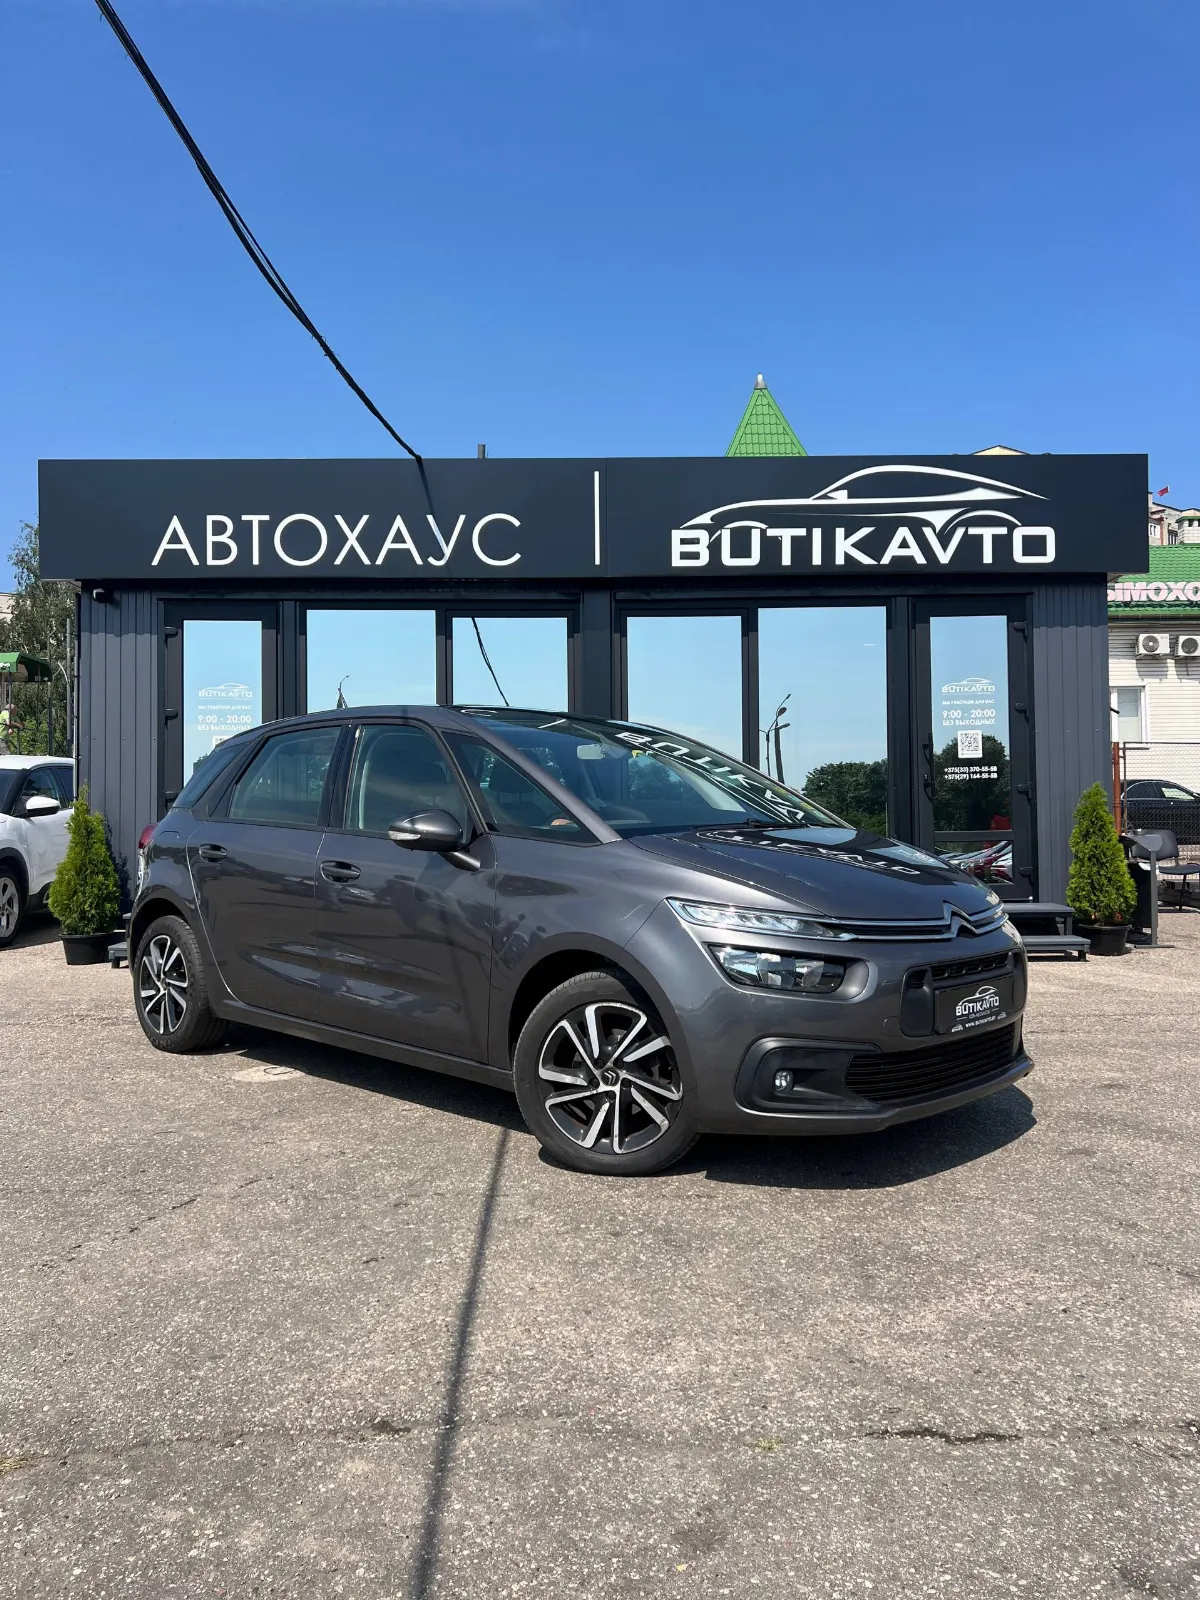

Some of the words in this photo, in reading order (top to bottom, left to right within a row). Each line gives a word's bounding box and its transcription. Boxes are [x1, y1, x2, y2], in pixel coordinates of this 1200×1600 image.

[151, 513, 522, 567] АВТОХАУС
[671, 526, 1056, 567] BUTIKAVTO
[198, 690, 253, 698] BUTIKAVTO
[941, 685, 996, 693] BUTIKAVTO
[197, 714, 218, 723] 9:00
[226, 714, 252, 723] 20:00
[942, 709, 962, 719] 9:00
[970, 708, 996, 718] 20:00
[955, 718, 996, 726] ВЫХОДНЫХ
[955, 996, 1000, 1016] BUTIKAVTO
